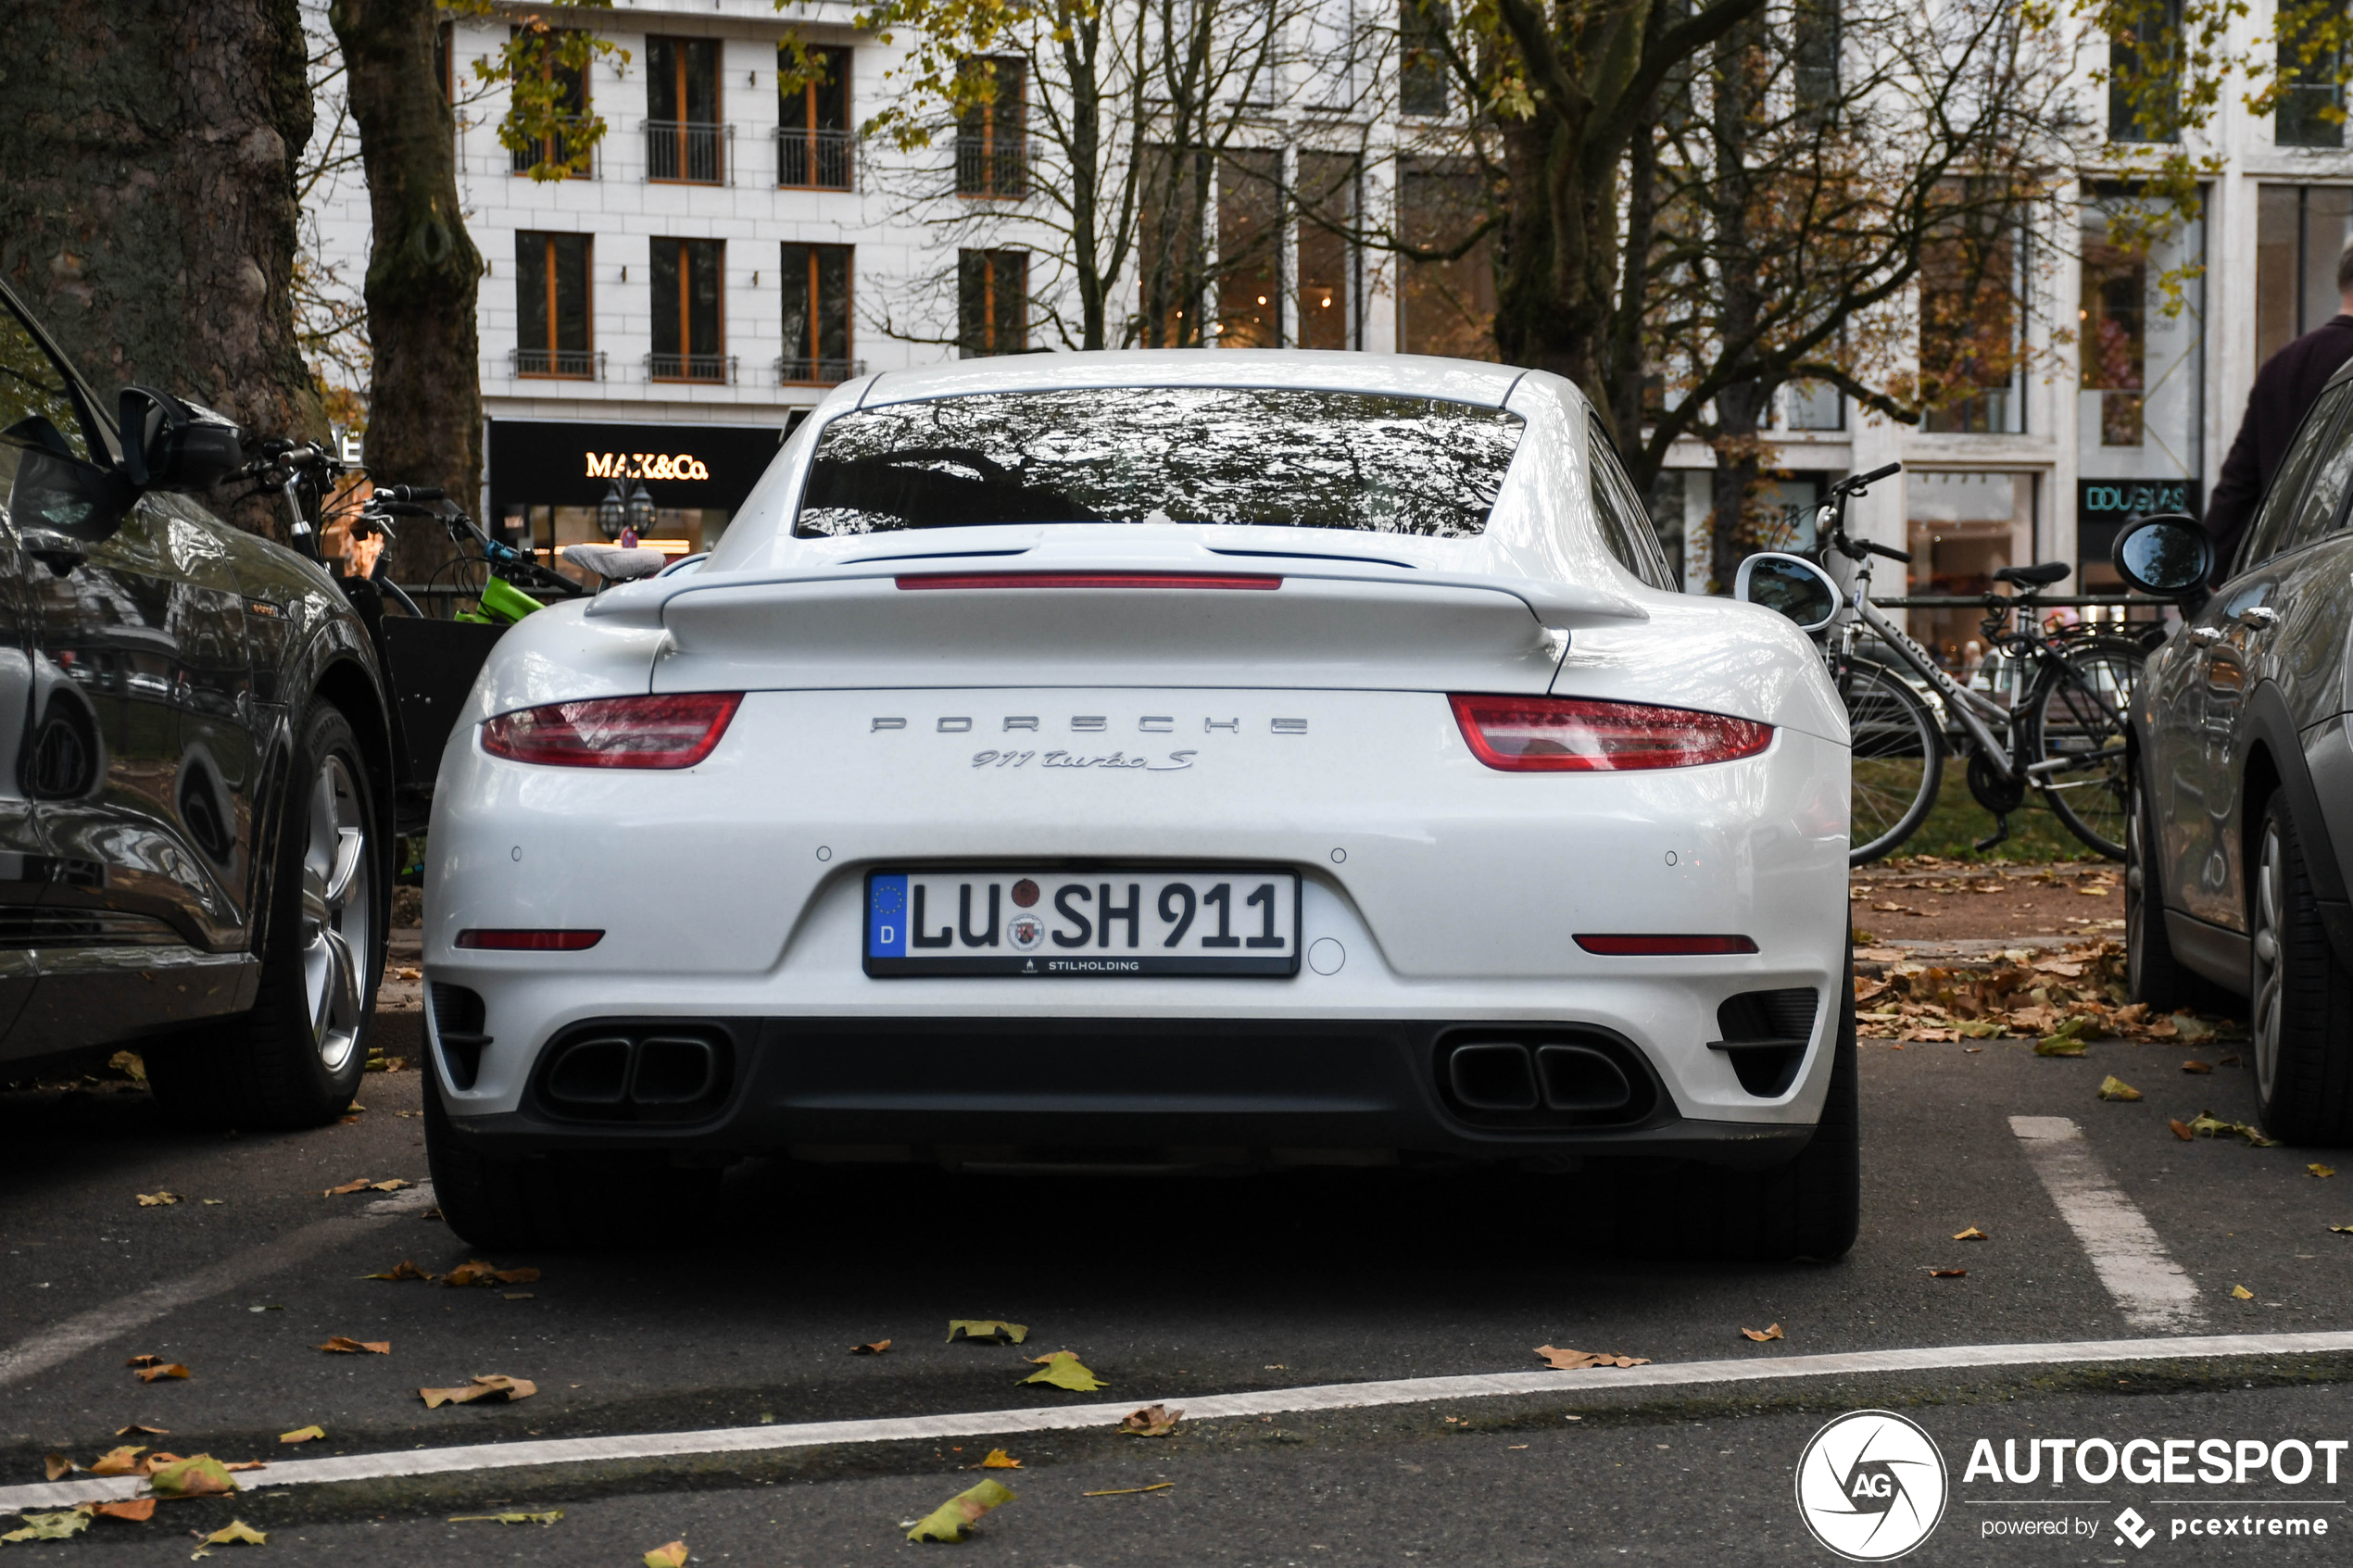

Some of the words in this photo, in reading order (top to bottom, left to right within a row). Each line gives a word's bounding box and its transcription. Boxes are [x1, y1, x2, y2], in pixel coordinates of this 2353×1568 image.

[585, 451, 710, 480] MAX&Co.
[870, 715, 1308, 734] PORSCHE
[972, 749, 1036, 769] 911
[1041, 749, 1148, 769] turbo
[1147, 749, 1199, 771] S
[912, 883, 1000, 948] LU
[1051, 883, 1140, 948] SH
[1158, 882, 1285, 948] 911
[880, 925, 895, 944] D
[1048, 960, 1139, 972] STILHOLDING
